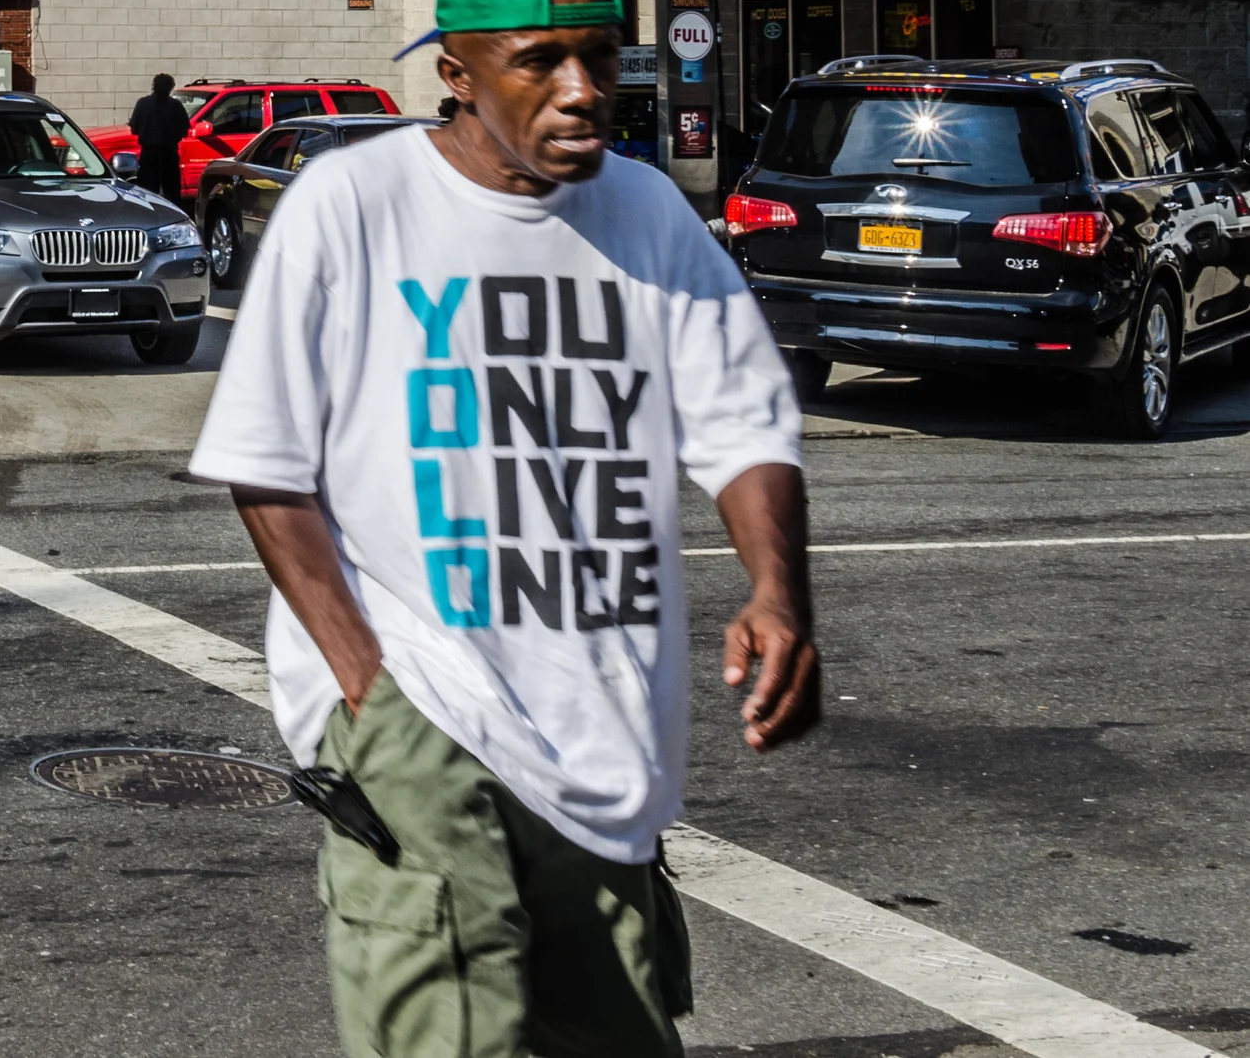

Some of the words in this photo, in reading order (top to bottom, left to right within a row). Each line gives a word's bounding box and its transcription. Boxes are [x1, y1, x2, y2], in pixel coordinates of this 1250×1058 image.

[752, 8, 765, 20] HOT
[768, 8, 787, 20] DOGS
[807, 5, 834, 18] COFFEE
[959, 0, 976, 12] TEA
[674, 28, 708, 44] FULL
[396, 275, 626, 361] YOU
[406, 366, 649, 450] ONLY
[411, 458, 650, 540] LIVE
[424, 546, 660, 631] ONCE
